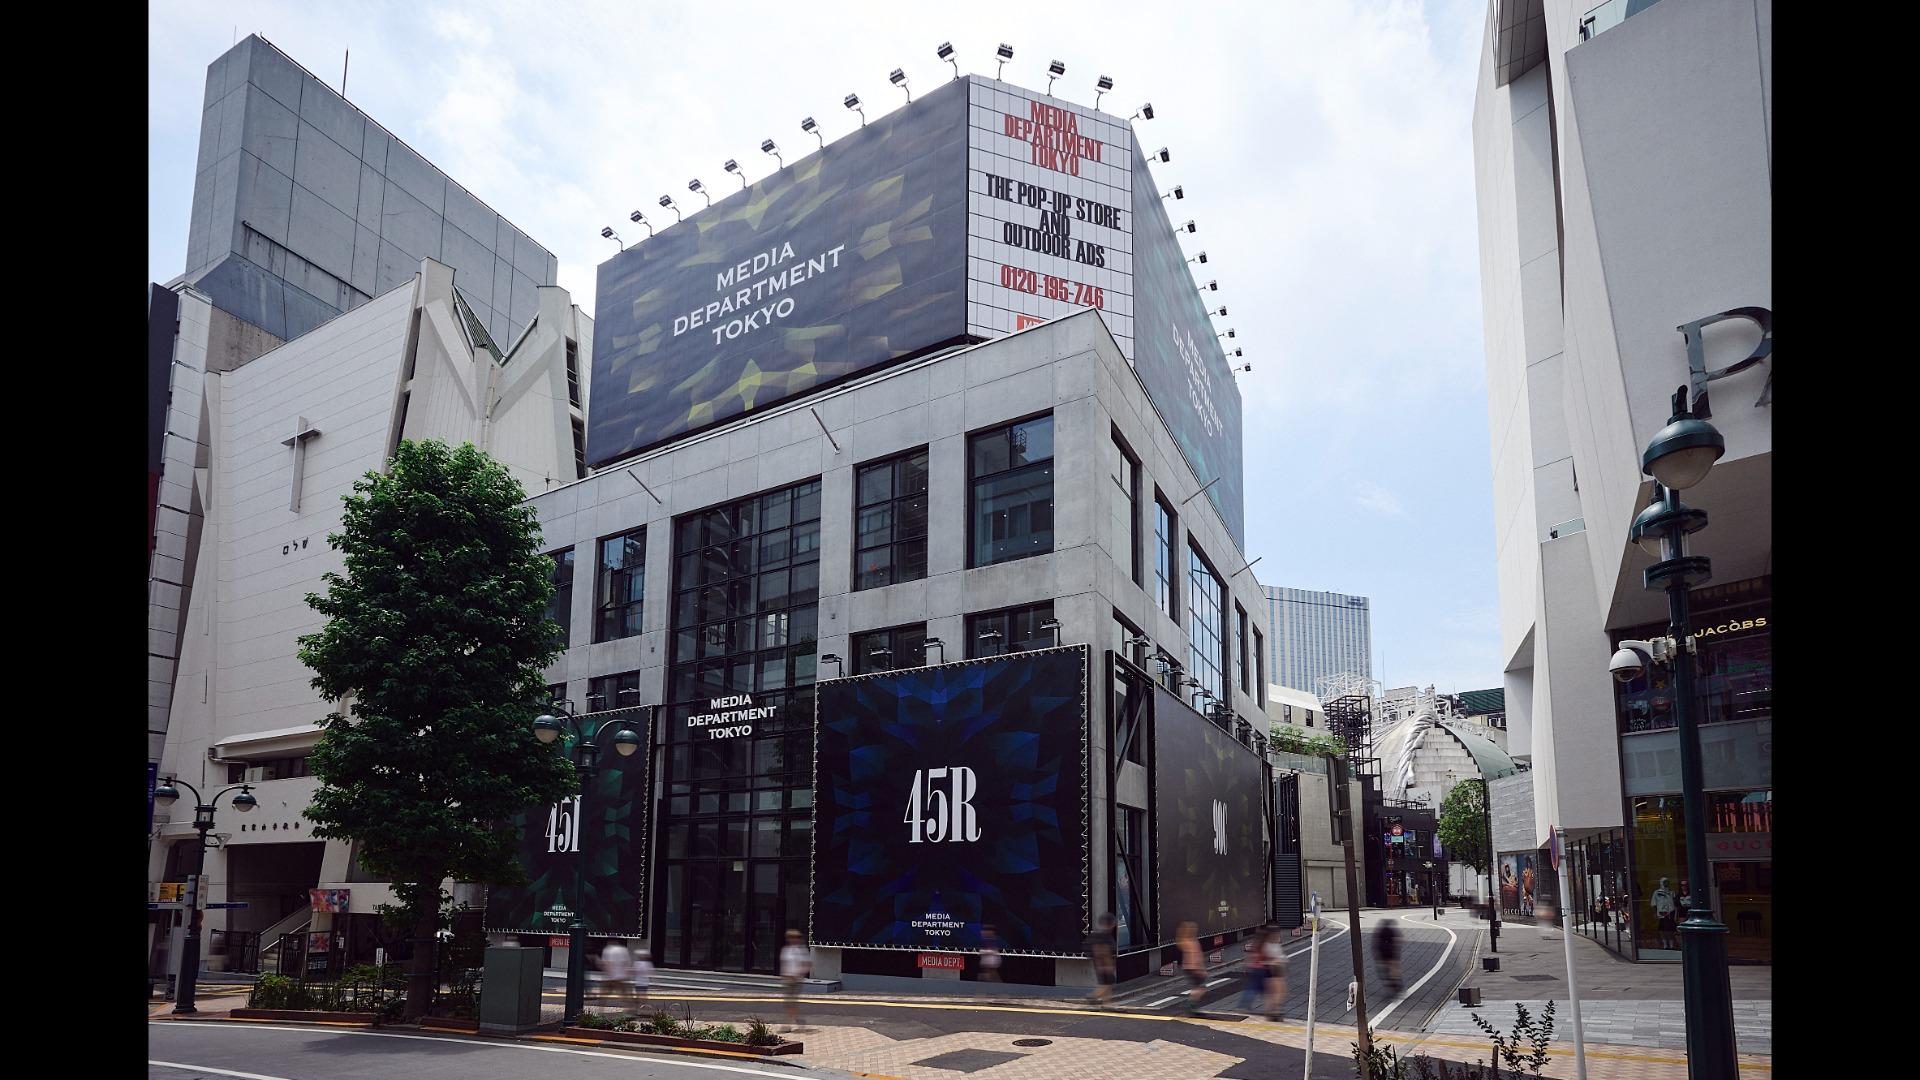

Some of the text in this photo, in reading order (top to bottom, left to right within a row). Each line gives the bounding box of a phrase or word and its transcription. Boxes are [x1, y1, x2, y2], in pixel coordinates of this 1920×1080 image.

[1004, 114, 1104, 163] DEPARTMENT
[1031, 101, 1079, 132] MEDIA
[1031, 142, 1080, 178] TOKYO
[986, 173, 1122, 231] THE POP-UP STORE
[1040, 210, 1071, 238] AND
[716, 240, 795, 292] MEDIA
[1004, 222, 1106, 268] OUTDOOR ADS
[673, 244, 846, 336] DEPARTMENT
[1000, 264, 1104, 310] 0120-195-746
[712, 297, 795, 345] TOKYO
[1172, 322, 1223, 437] DEPARTMENT
[1187, 329, 1212, 393] MEDIA
[1187, 378, 1213, 437] TOKYO
[688, 706, 777, 727] DEPARTMENT
[711, 694, 752, 709] MEDIA
[708, 725, 752, 739] TOKYO
[904, 765, 982, 843] 45R
[911, 920, 965, 928] DEPARTMENT
[922, 955, 963, 968] MEDIA DEPT.
